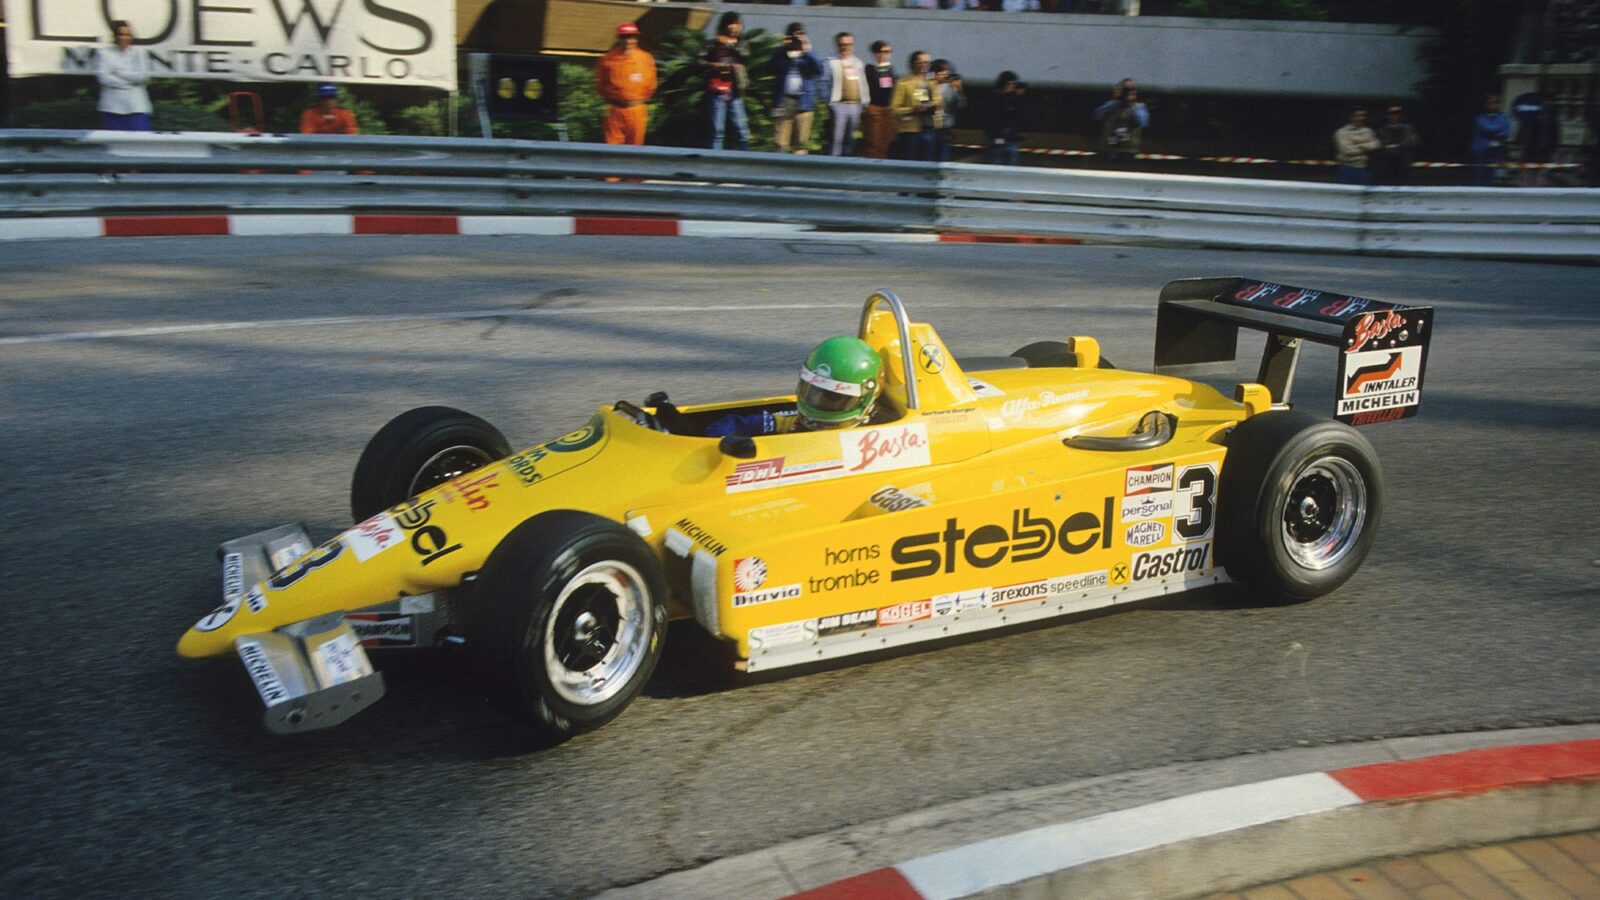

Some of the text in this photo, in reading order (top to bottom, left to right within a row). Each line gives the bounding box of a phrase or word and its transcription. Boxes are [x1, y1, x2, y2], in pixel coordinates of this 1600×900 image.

[30, 0, 434, 56] LOEWS
[1363, 376, 1416, 393] INNTALER
[1342, 392, 1416, 413] MICHELIN
[1128, 472, 1172, 487] CHAMPION
[1122, 500, 1173, 518] personal
[1175, 465, 1216, 540] 3
[675, 518, 727, 557] MICHELIN
[890, 495, 1115, 584] stebel
[825, 544, 881, 567] horns
[1132, 542, 1210, 581] Castrol
[227, 553, 243, 597] MICHELIN
[808, 568, 881, 594] trombe
[1050, 573, 1107, 593] speedline
[991, 582, 1048, 602] arexons
[818, 616, 841, 630] JIM
[240, 642, 283, 701] MICHELIN
